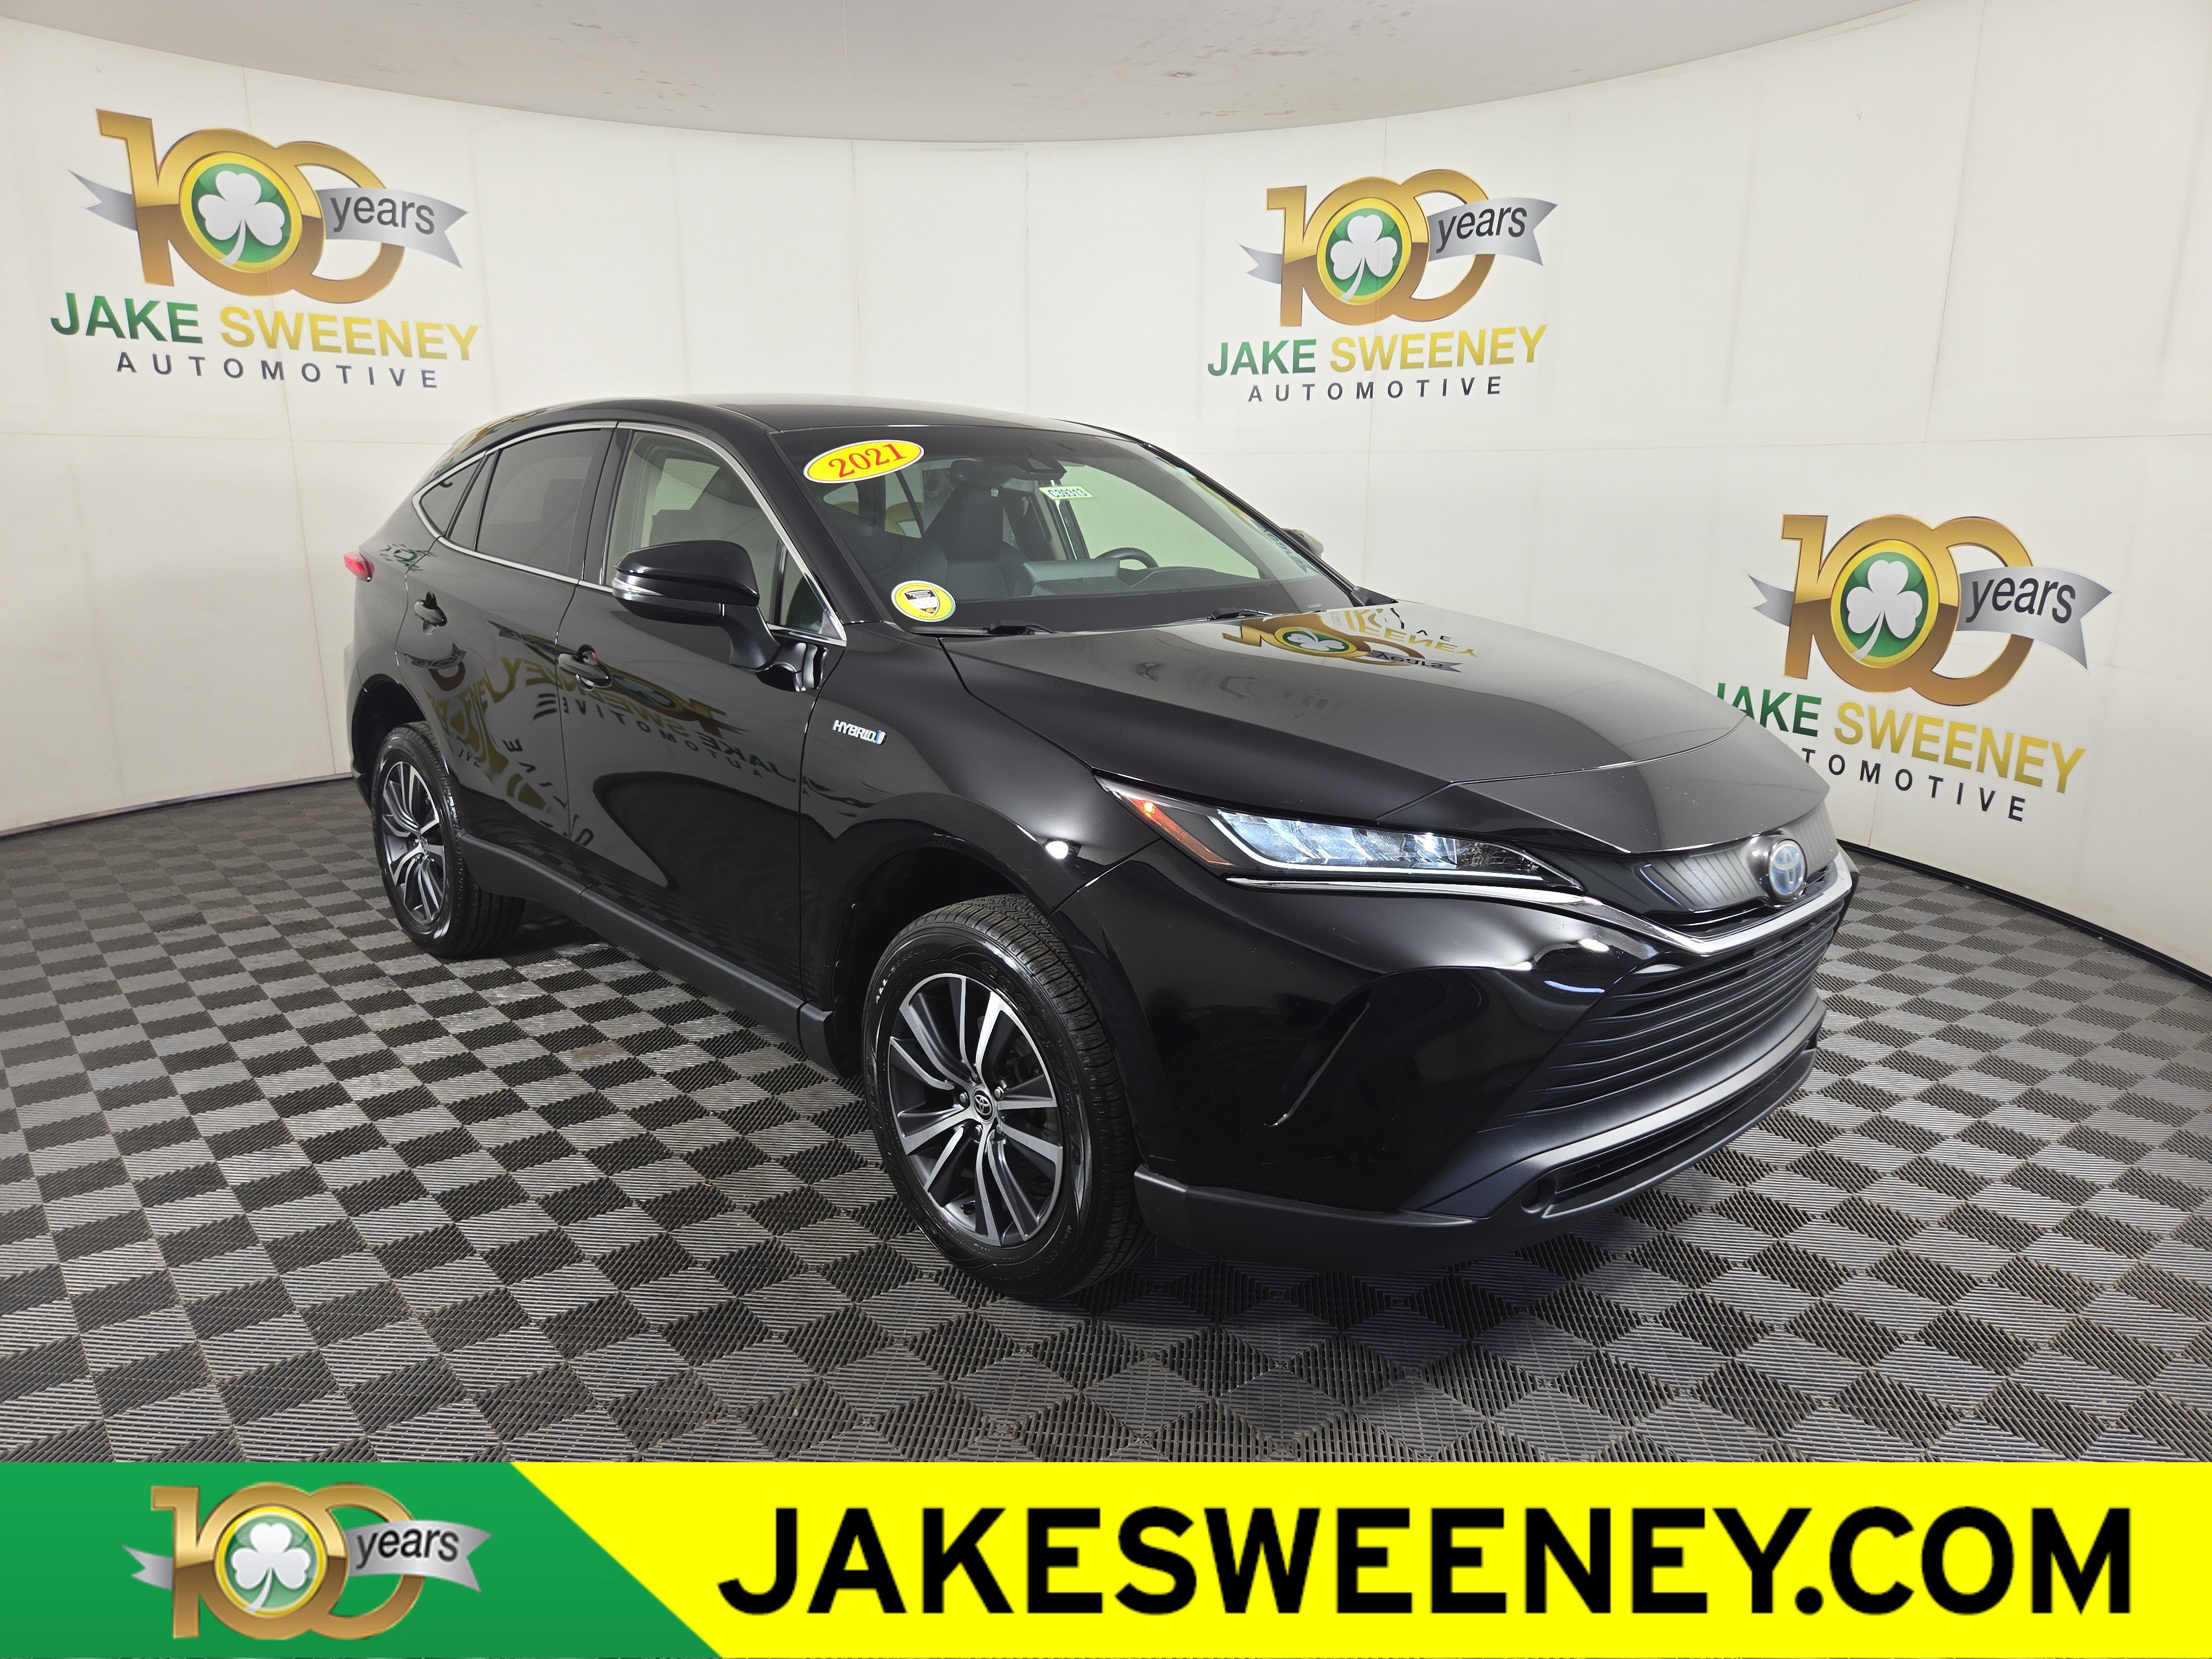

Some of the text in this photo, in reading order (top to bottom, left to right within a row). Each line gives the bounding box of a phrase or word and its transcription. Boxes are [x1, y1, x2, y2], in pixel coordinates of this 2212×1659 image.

[96, 109, 435, 303] 100 years
[1266, 169, 1528, 327] 100 years
[50, 292, 478, 361] JAKE SWEENEY
[1207, 324, 1548, 376] JAKE SWEENEY
[116, 351, 438, 389] AUTOMOTIVE
[1248, 376, 1502, 402] AUTOMOTIVE
[828, 443, 907, 478] 2021
[1781, 514, 2076, 706] 100 years
[833, 719, 877, 743] HYBRID
[1835, 702, 2086, 795] SWEENEY
[1802, 747, 2026, 822] TOMOTIVE
